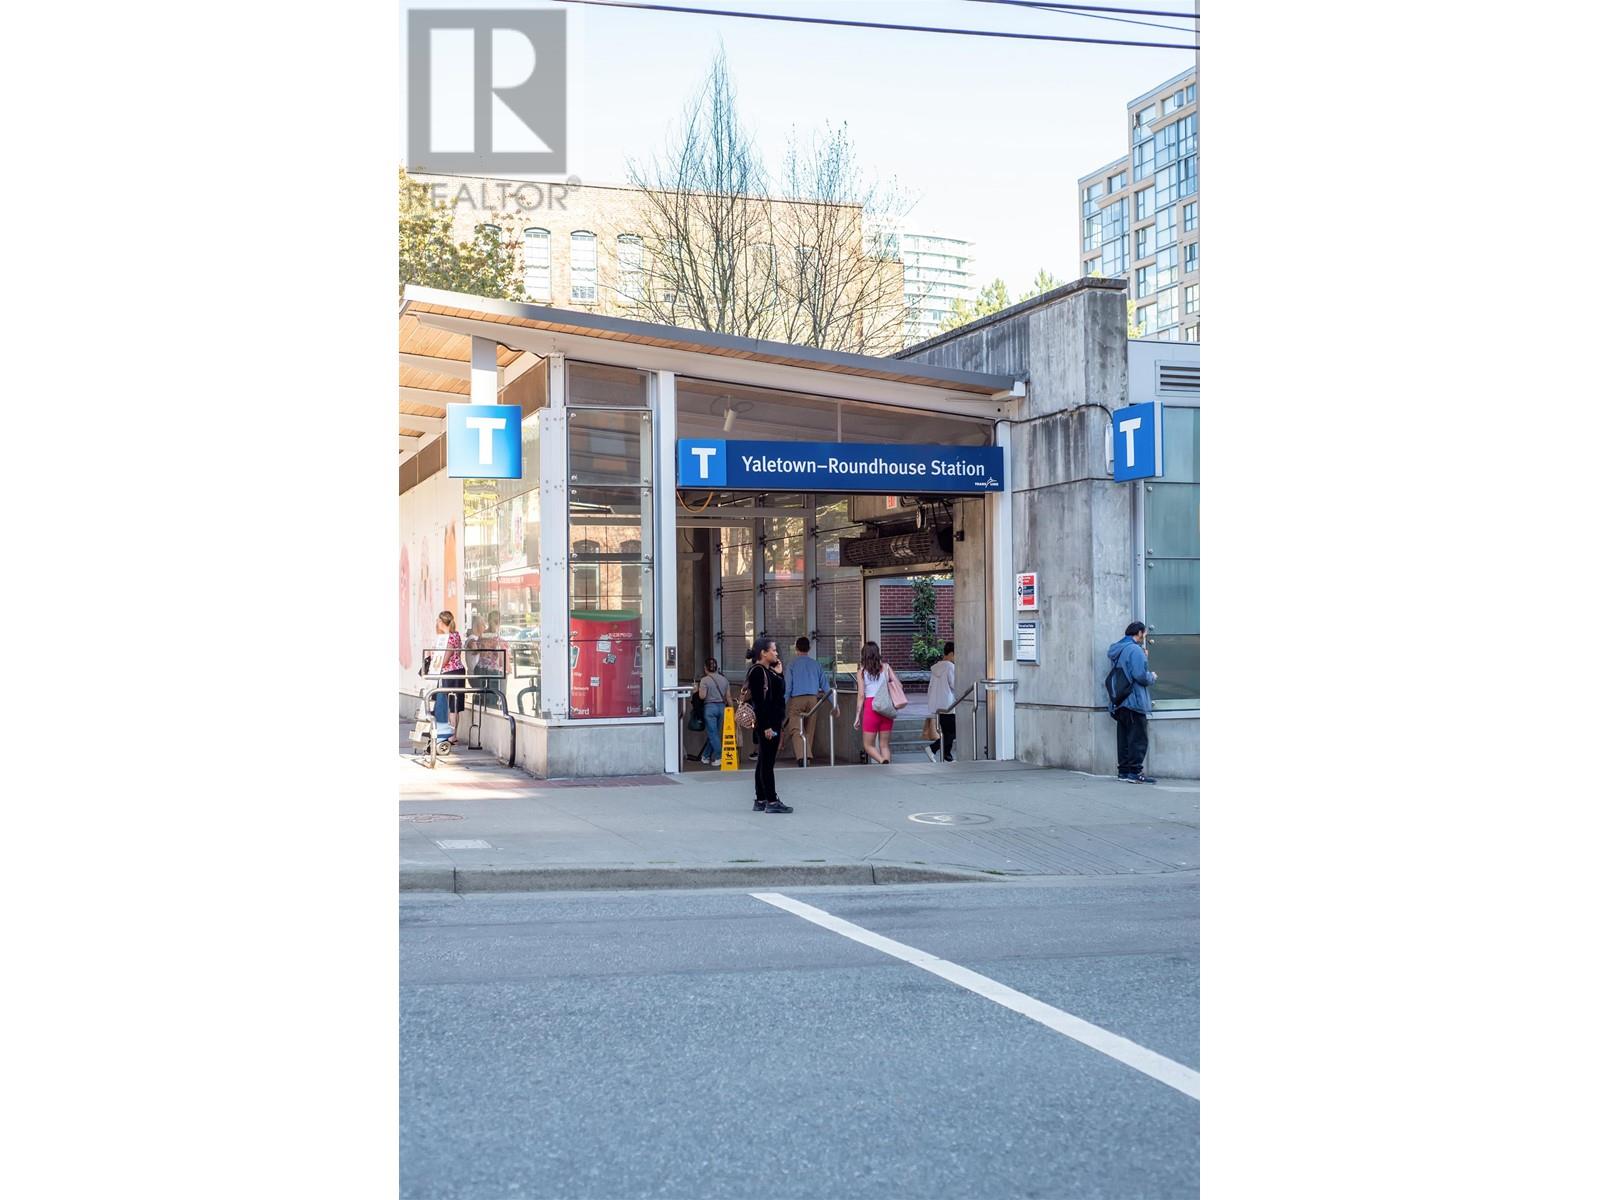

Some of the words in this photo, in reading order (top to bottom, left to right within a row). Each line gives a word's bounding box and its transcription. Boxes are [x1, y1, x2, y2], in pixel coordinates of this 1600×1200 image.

[466, 416, 507, 465] T
[1119, 417, 1142, 468] T
[691, 447, 717, 479] T
[931, 459, 986, 477] Station
